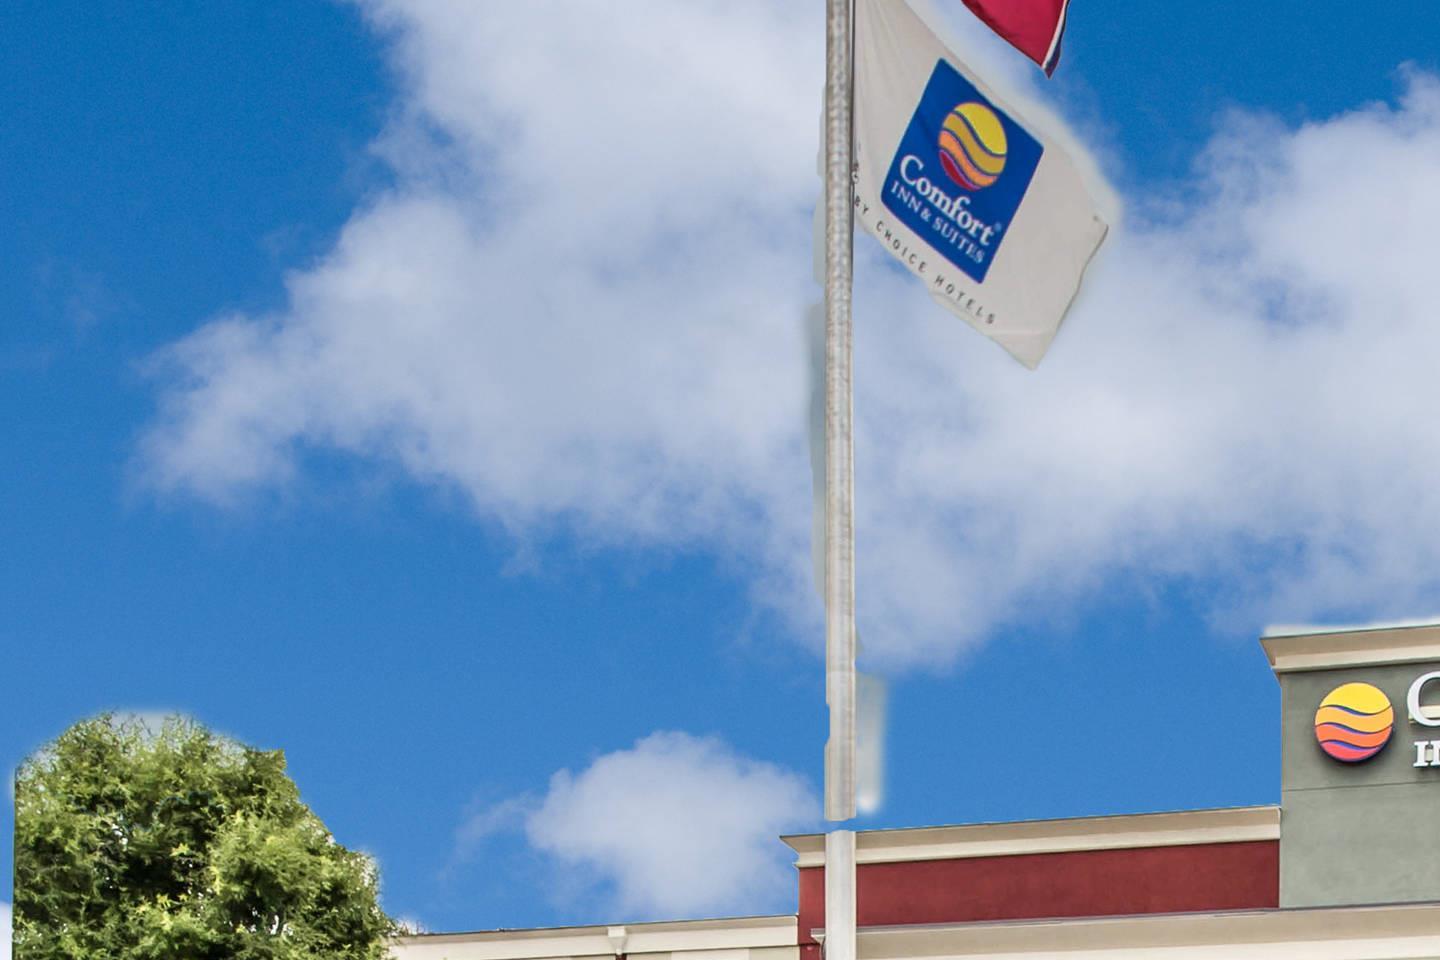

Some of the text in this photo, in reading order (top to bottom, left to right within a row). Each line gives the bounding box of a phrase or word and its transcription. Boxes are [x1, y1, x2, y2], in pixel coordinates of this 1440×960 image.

[900, 154, 995, 246] Comfort
[876, 221, 928, 273] CHOICE
[935, 275, 996, 325] HOTELS
